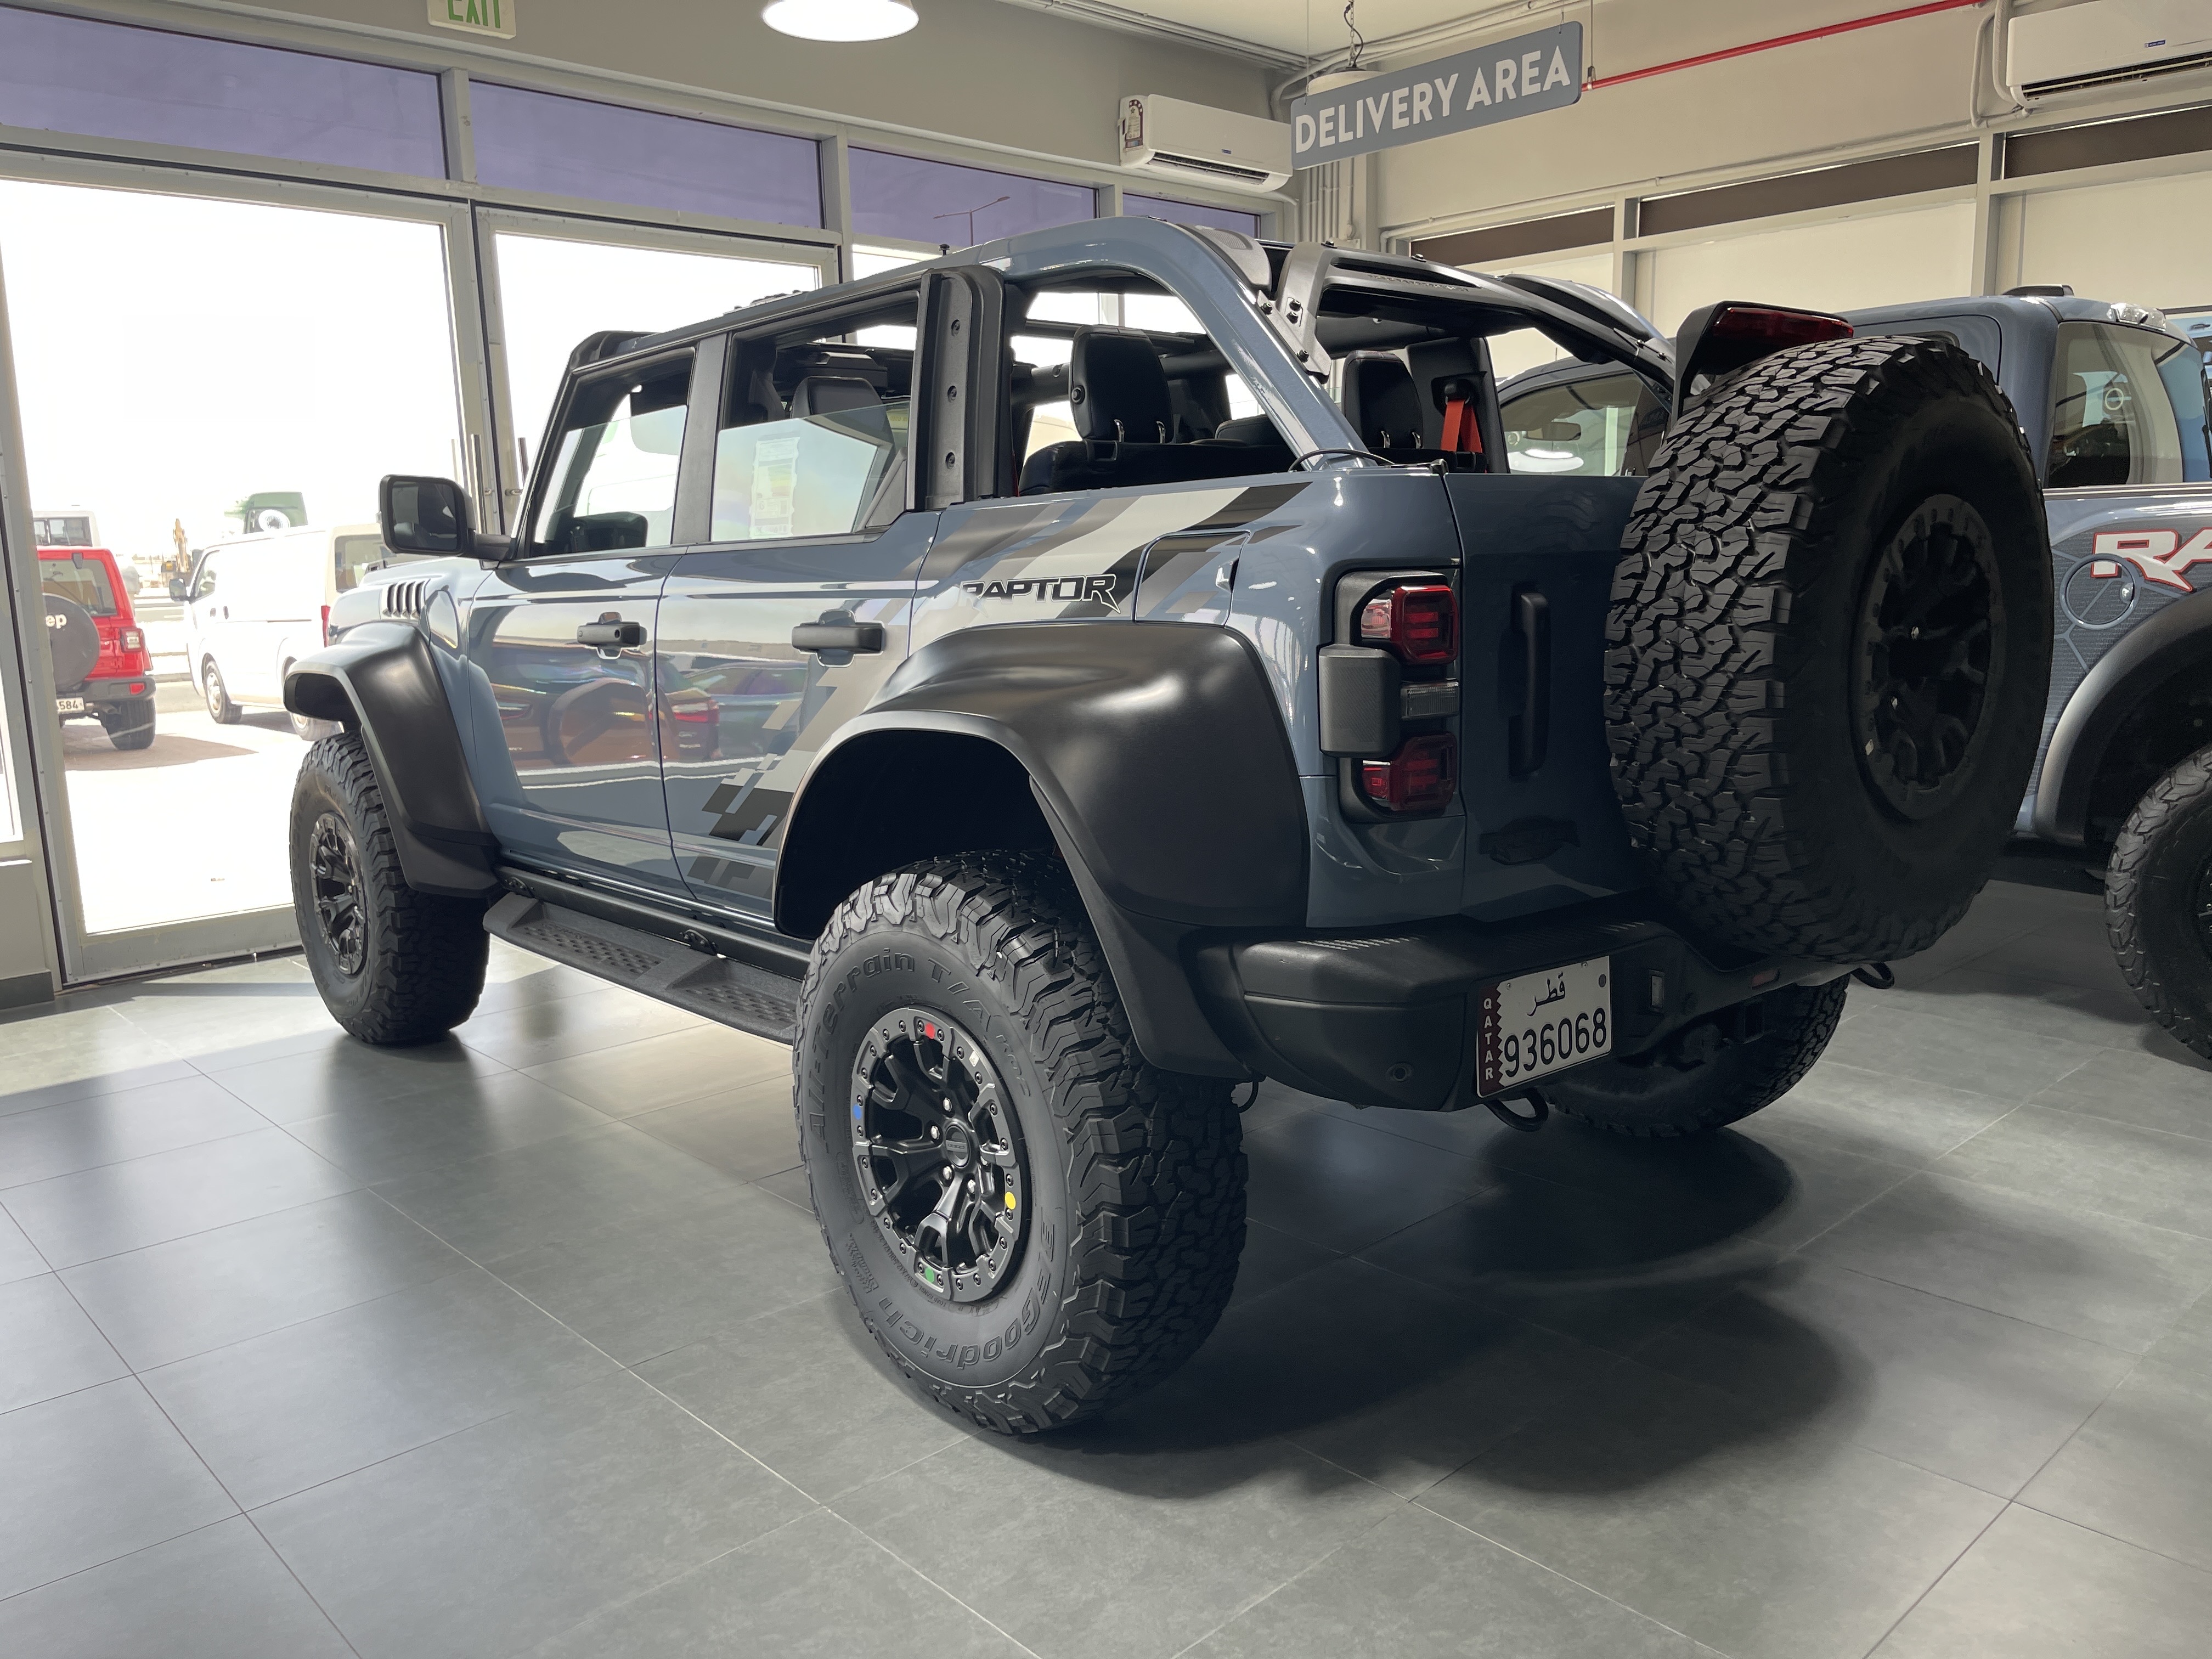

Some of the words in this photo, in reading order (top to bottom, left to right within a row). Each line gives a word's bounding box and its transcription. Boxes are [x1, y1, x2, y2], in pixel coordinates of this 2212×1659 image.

[1295, 73, 1460, 154] DELIVERY
[1465, 46, 1571, 111] AREA
[45, 614, 67, 629] ep
[959, 573, 1121, 618] RAPTOR
[1527, 971, 1566, 1016] قطر
[1483, 997, 1494, 1081] QATAR
[1504, 1008, 1607, 1077] 936068
